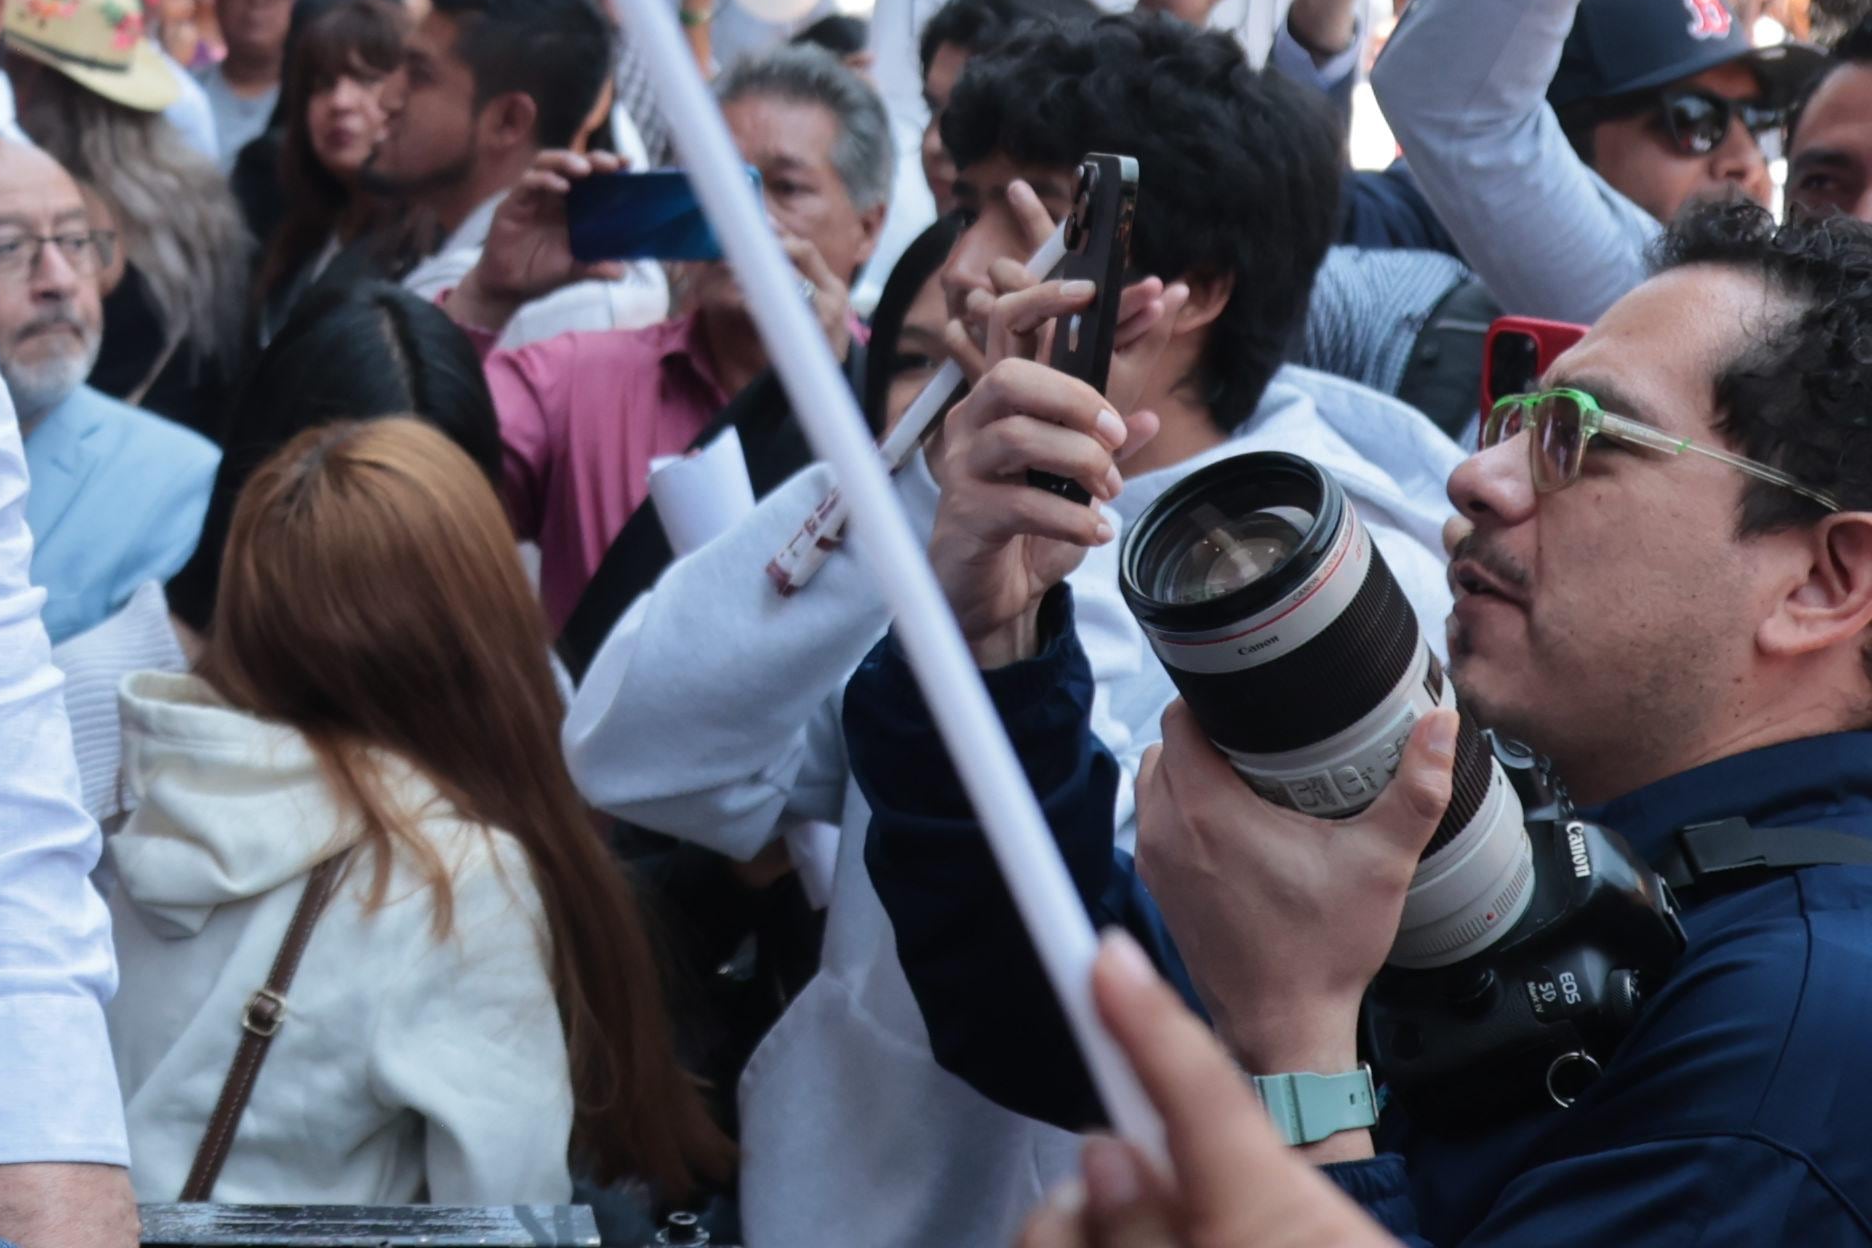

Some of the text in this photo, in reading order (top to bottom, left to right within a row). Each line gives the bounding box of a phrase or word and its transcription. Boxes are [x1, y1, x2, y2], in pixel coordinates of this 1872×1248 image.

[1238, 635, 1280, 656] Canon
[1566, 821, 1591, 878] Canon
[1527, 981, 1540, 1004] Mark
[1539, 981, 1557, 1002] 5D
[1559, 971, 1581, 1005] EOS
